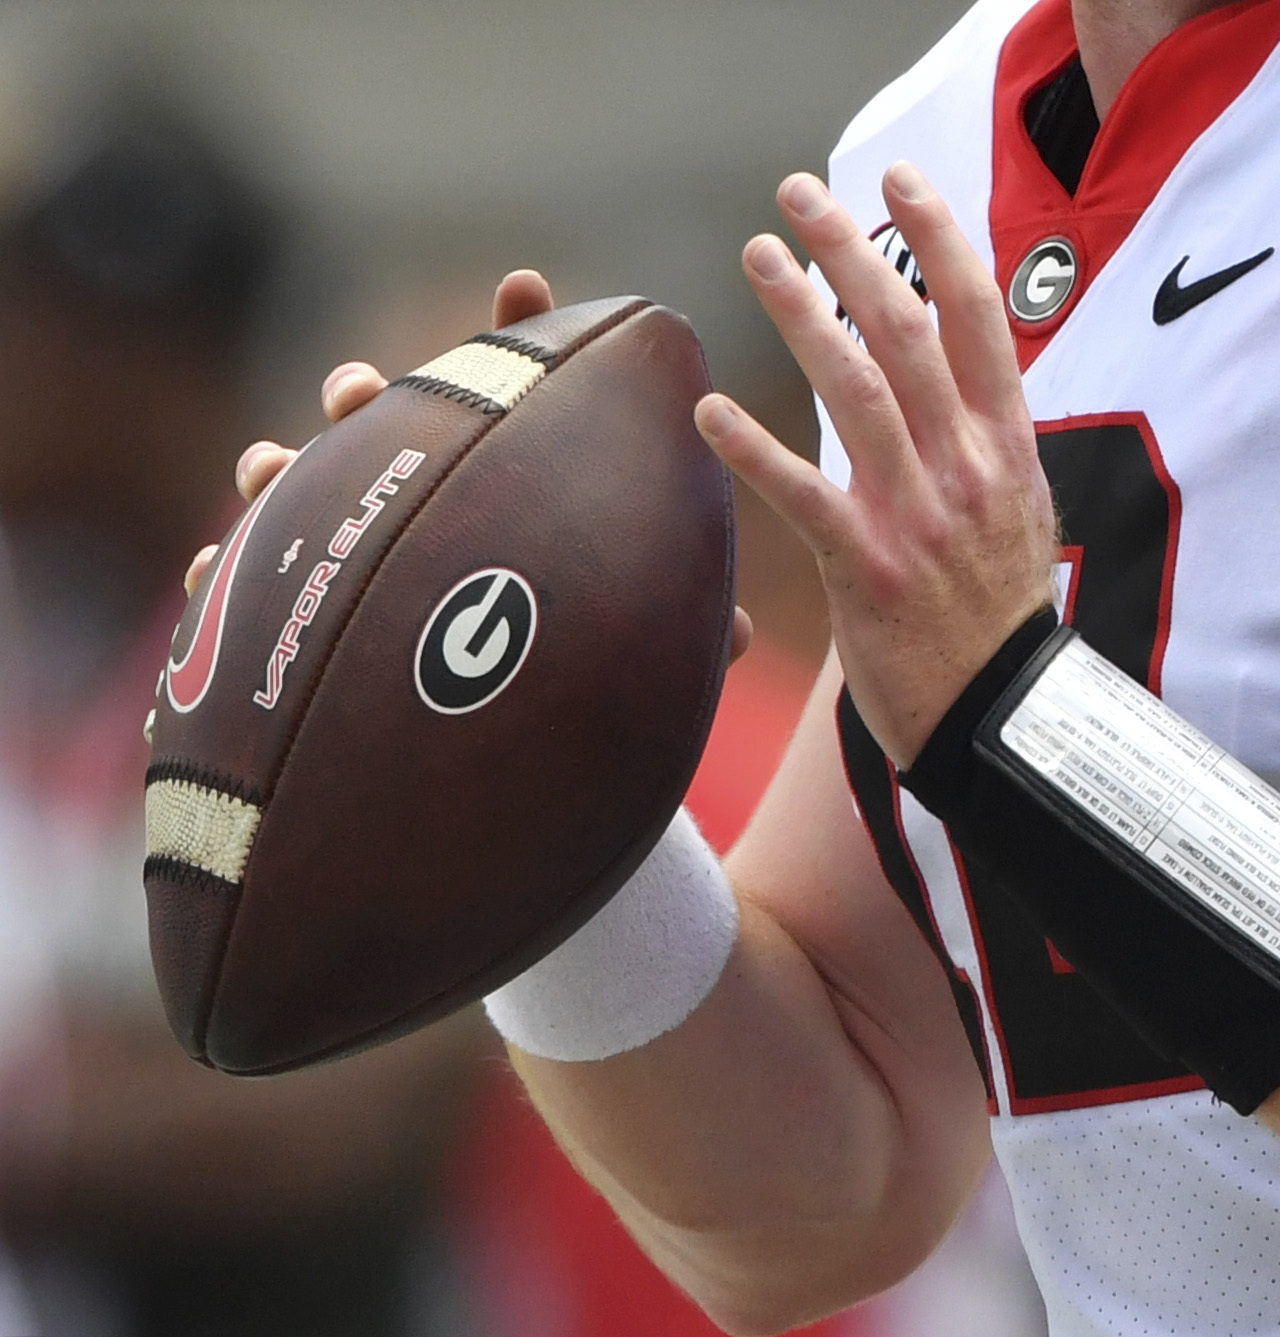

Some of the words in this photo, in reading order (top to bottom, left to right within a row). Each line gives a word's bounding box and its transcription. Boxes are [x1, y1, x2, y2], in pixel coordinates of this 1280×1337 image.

[1013, 239, 1076, 318] G
[252, 560, 341, 711] VAPOR
[327, 447, 427, 561] ELITE
[421, 573, 532, 706] G
